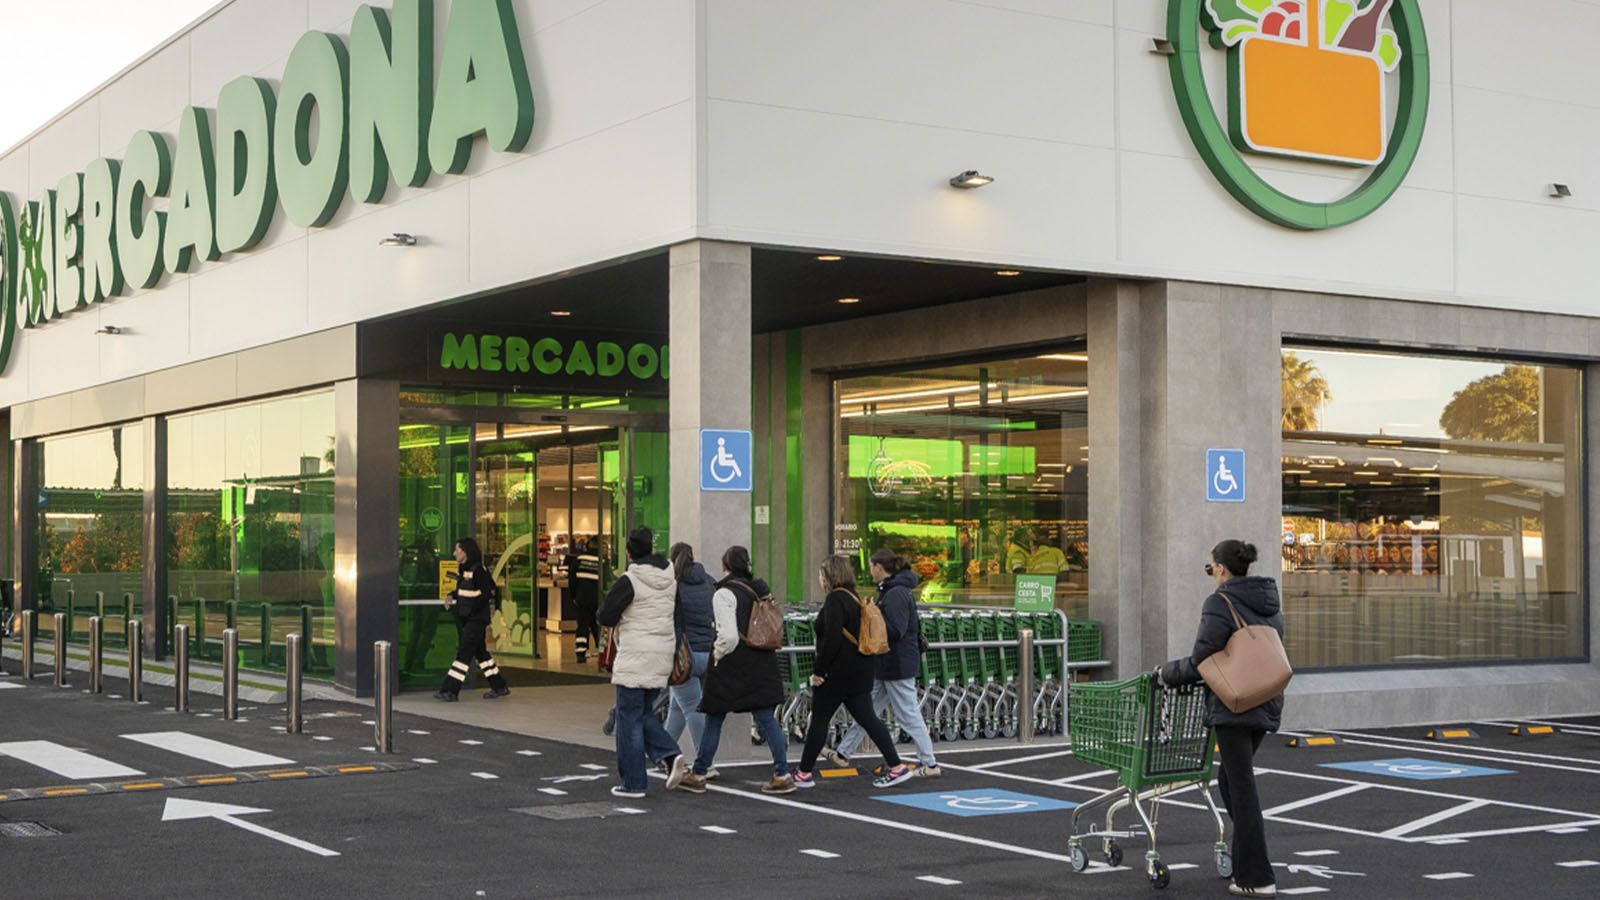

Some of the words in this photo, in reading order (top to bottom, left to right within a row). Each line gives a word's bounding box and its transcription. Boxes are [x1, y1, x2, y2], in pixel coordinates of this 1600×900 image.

[16, 0, 534, 331] MERCADONA
[440, 332, 669, 380] MERCADO
[1017, 589, 1037, 597] CESTA
[1018, 581, 1040, 589] CARRO
